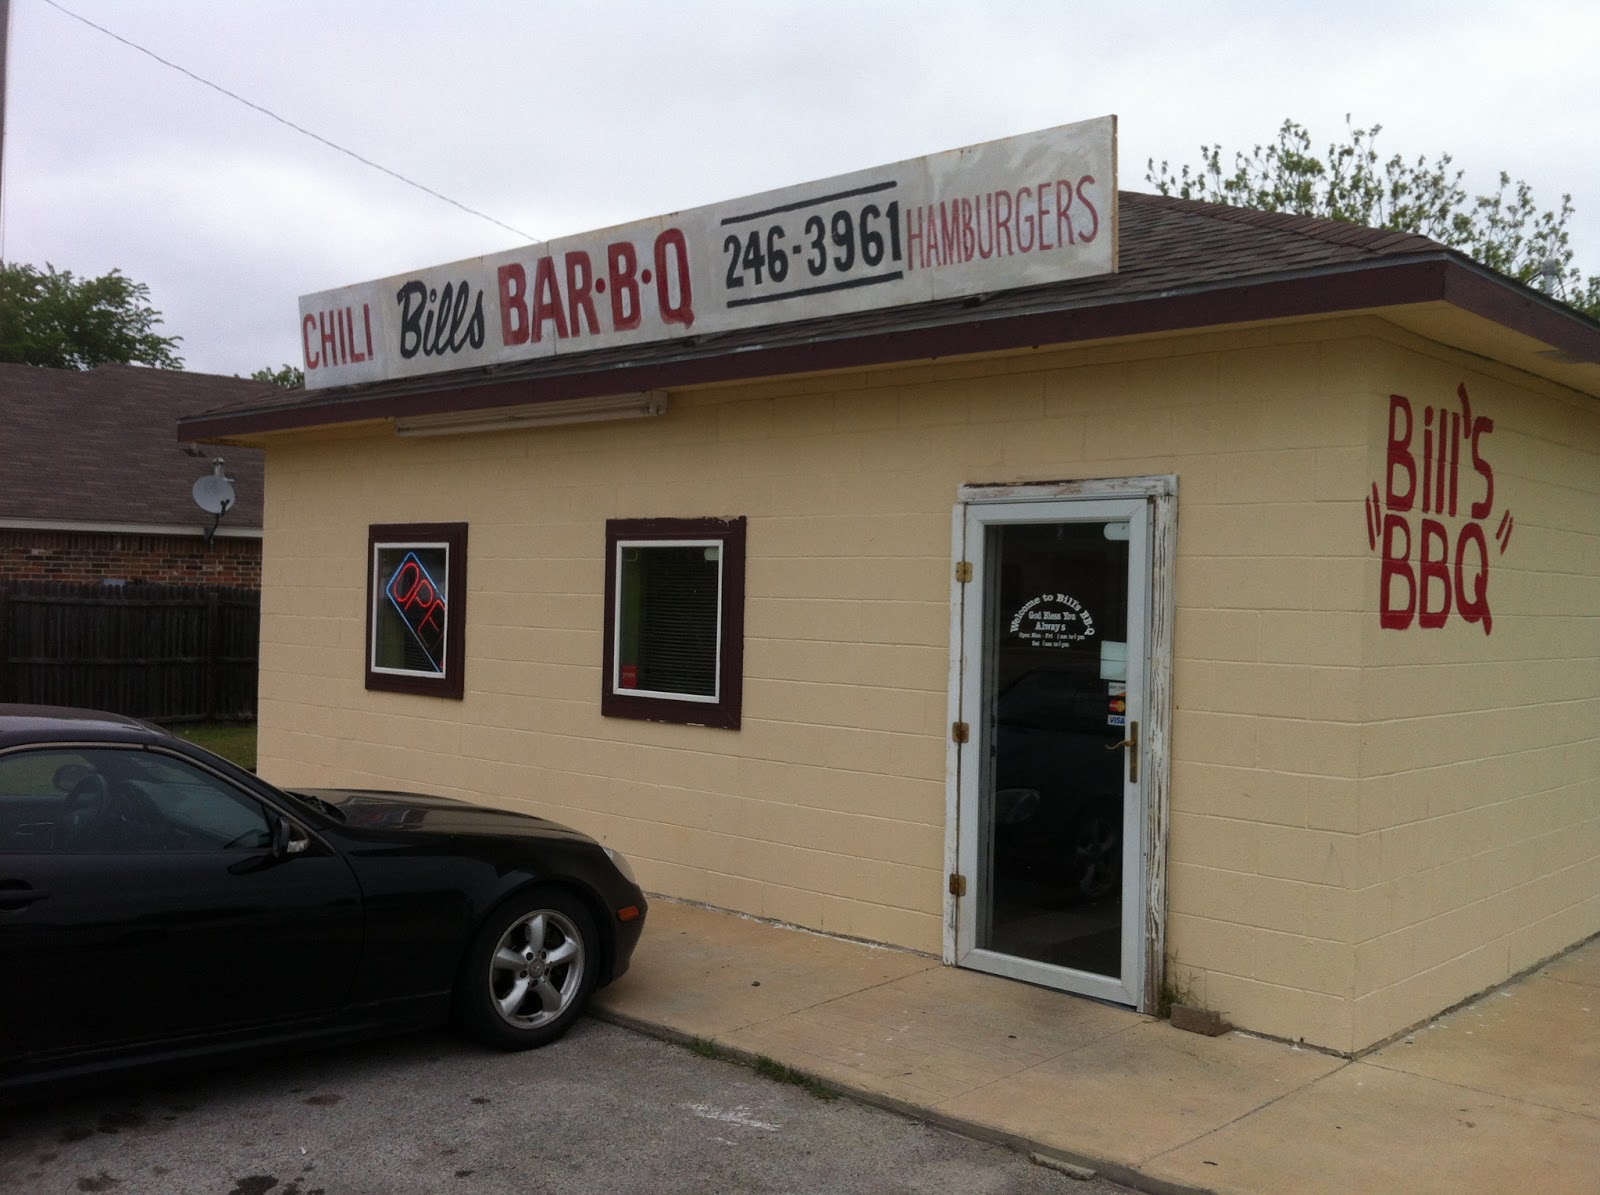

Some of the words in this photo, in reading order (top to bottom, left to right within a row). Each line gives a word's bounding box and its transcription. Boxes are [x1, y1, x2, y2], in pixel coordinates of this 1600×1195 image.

[723, 200, 903, 290] 246-3961
[906, 175, 1099, 271] HAMBURGERS
[302, 303, 375, 369] CHILI
[397, 279, 486, 359] Bills
[1386, 382, 1494, 520] Bill's
[1010, 597, 1041, 633] Welcome
[1042, 593, 1054, 602] to
[1056, 593, 1082, 611] Bill's
[1028, 611, 1042, 620] God
[1043, 611, 1061, 620] Bless
[1062, 611, 1076, 621] You
[1035, 621, 1066, 632] Always
[1110, 716, 1125, 724] VISA
